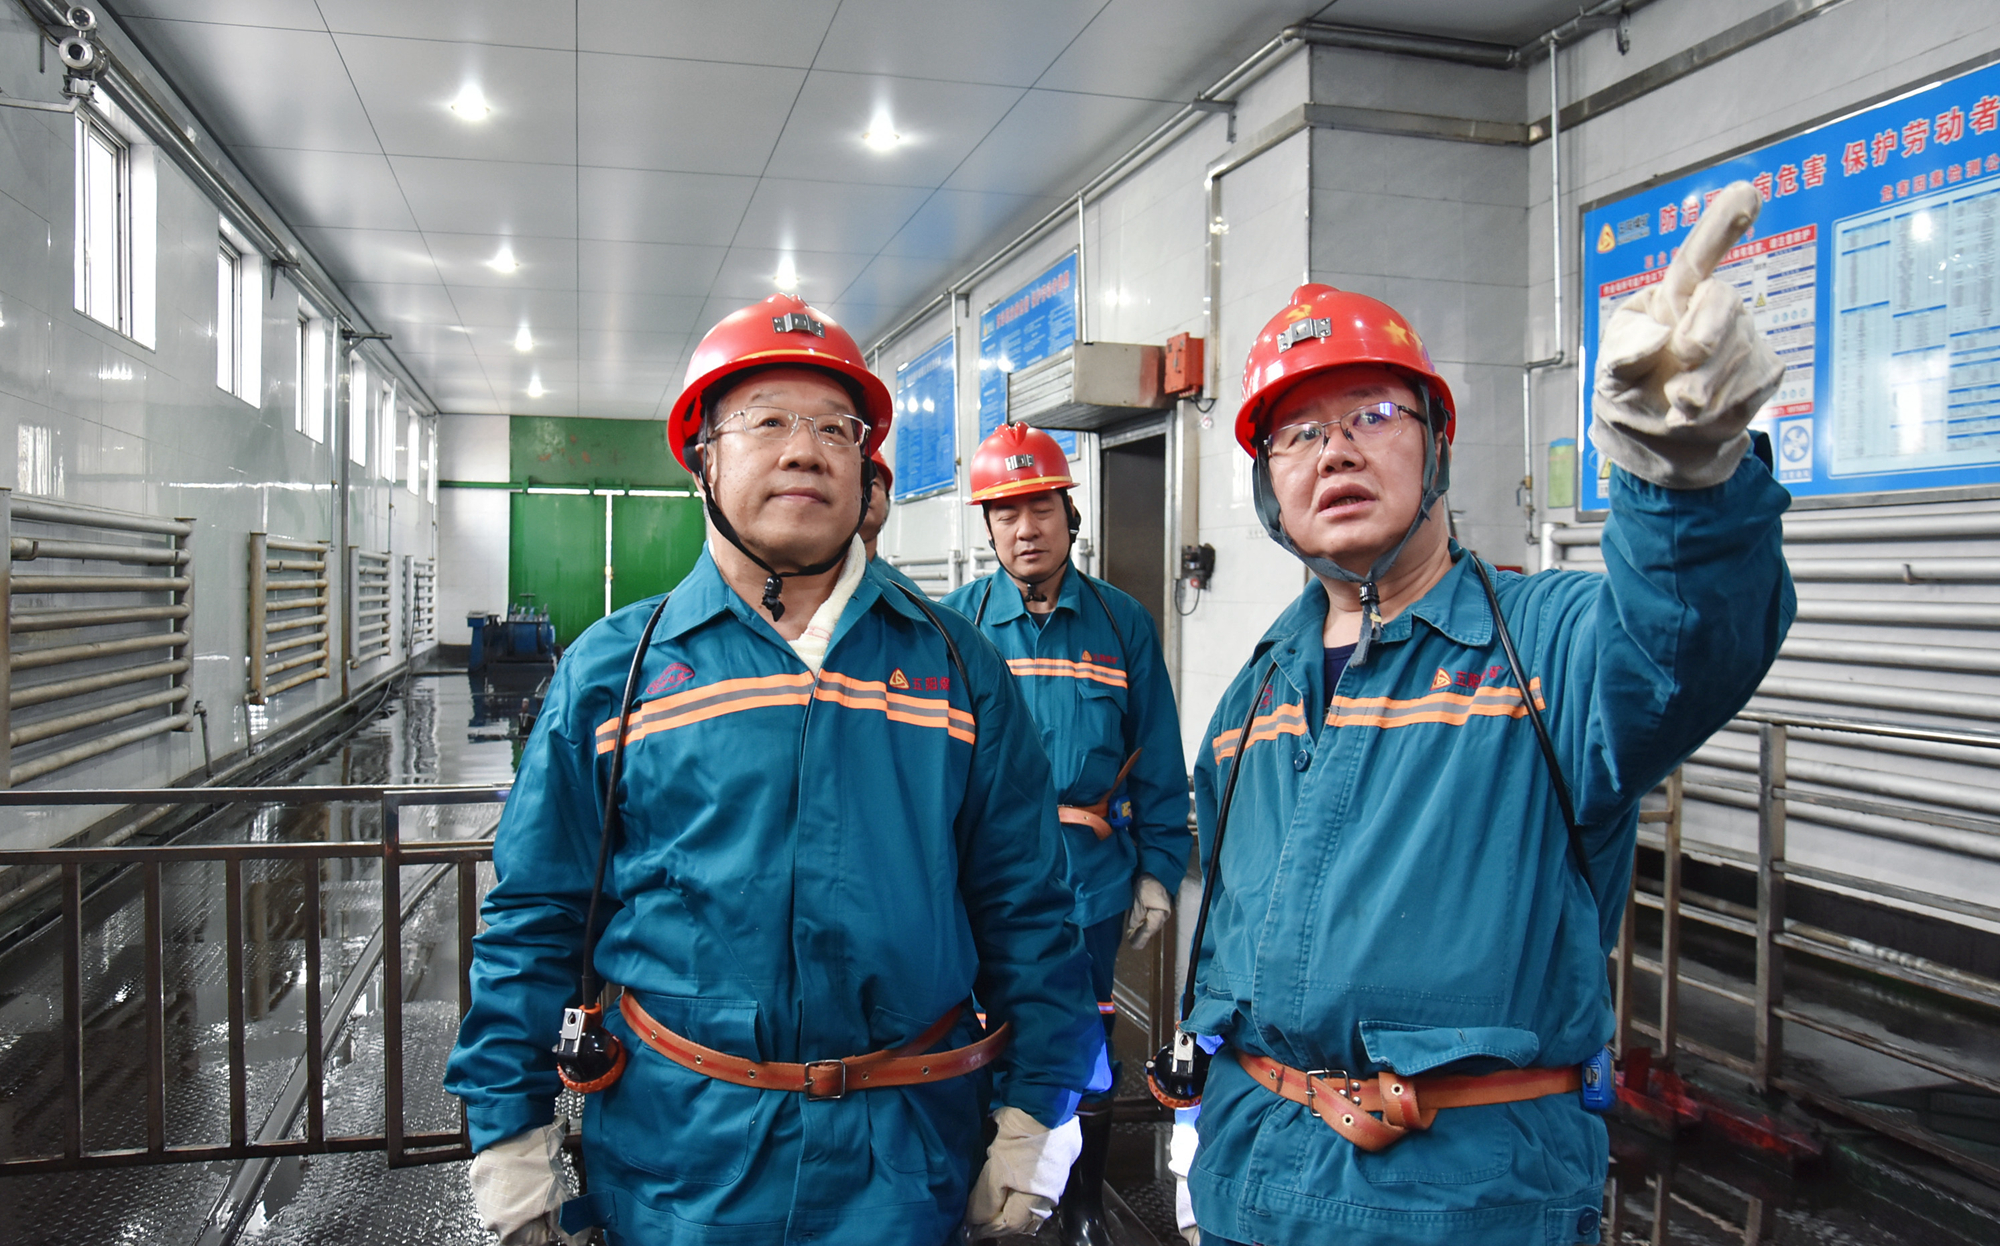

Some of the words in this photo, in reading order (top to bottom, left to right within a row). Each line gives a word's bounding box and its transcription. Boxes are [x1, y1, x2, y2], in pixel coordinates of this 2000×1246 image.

[1841, 95, 2000, 176] 保护劳动者
